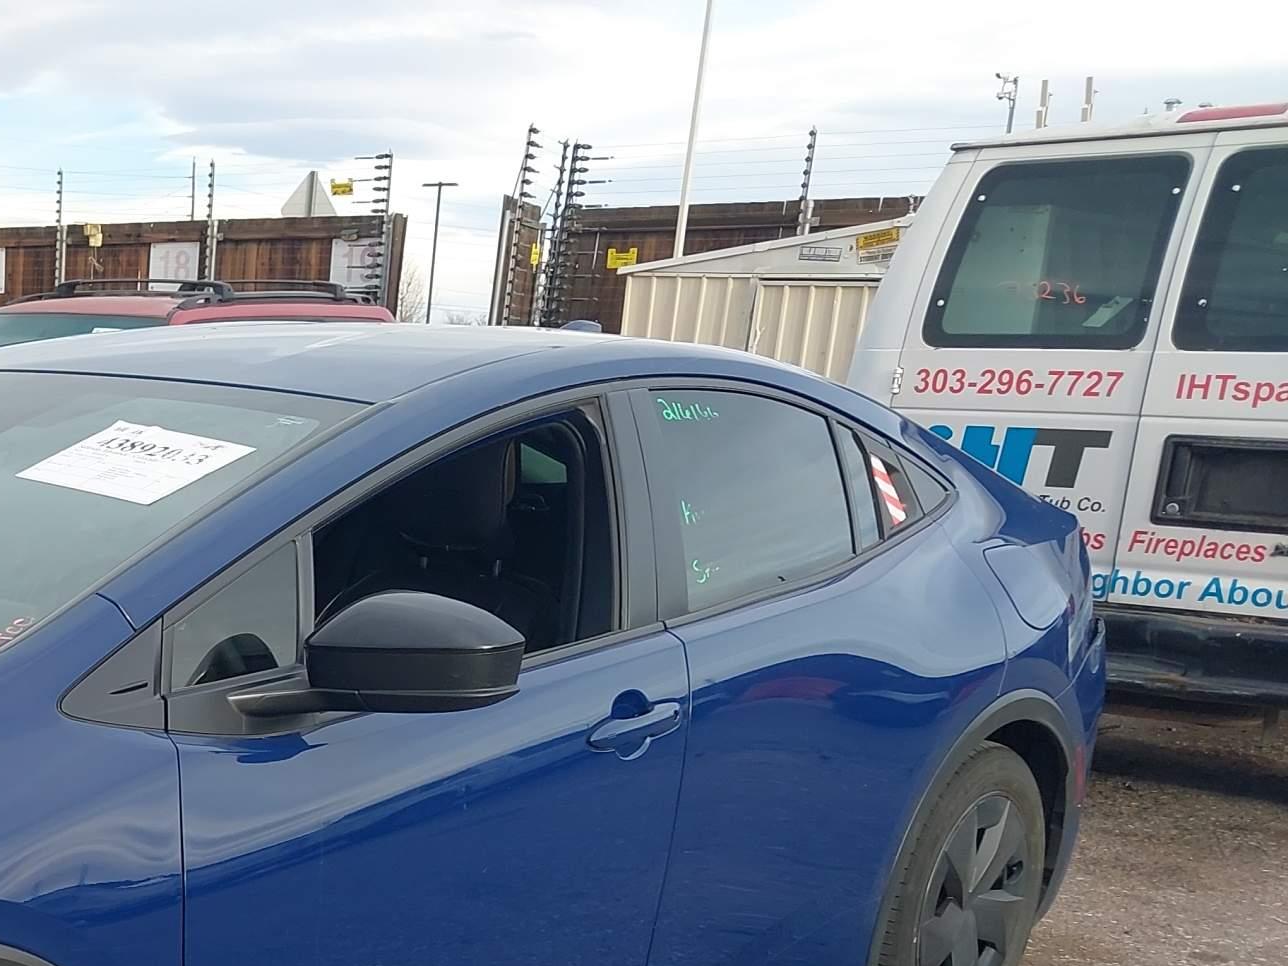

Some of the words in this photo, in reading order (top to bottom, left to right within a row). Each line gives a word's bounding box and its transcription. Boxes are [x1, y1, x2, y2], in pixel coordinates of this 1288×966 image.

[160, 249, 191, 280] 18
[913, 368, 1124, 398] 303-296-7727
[1077, 497, 1106, 513] Co.
[1128, 530, 1267, 562] Fireplaces
[1092, 568, 1191, 600] ghbor
